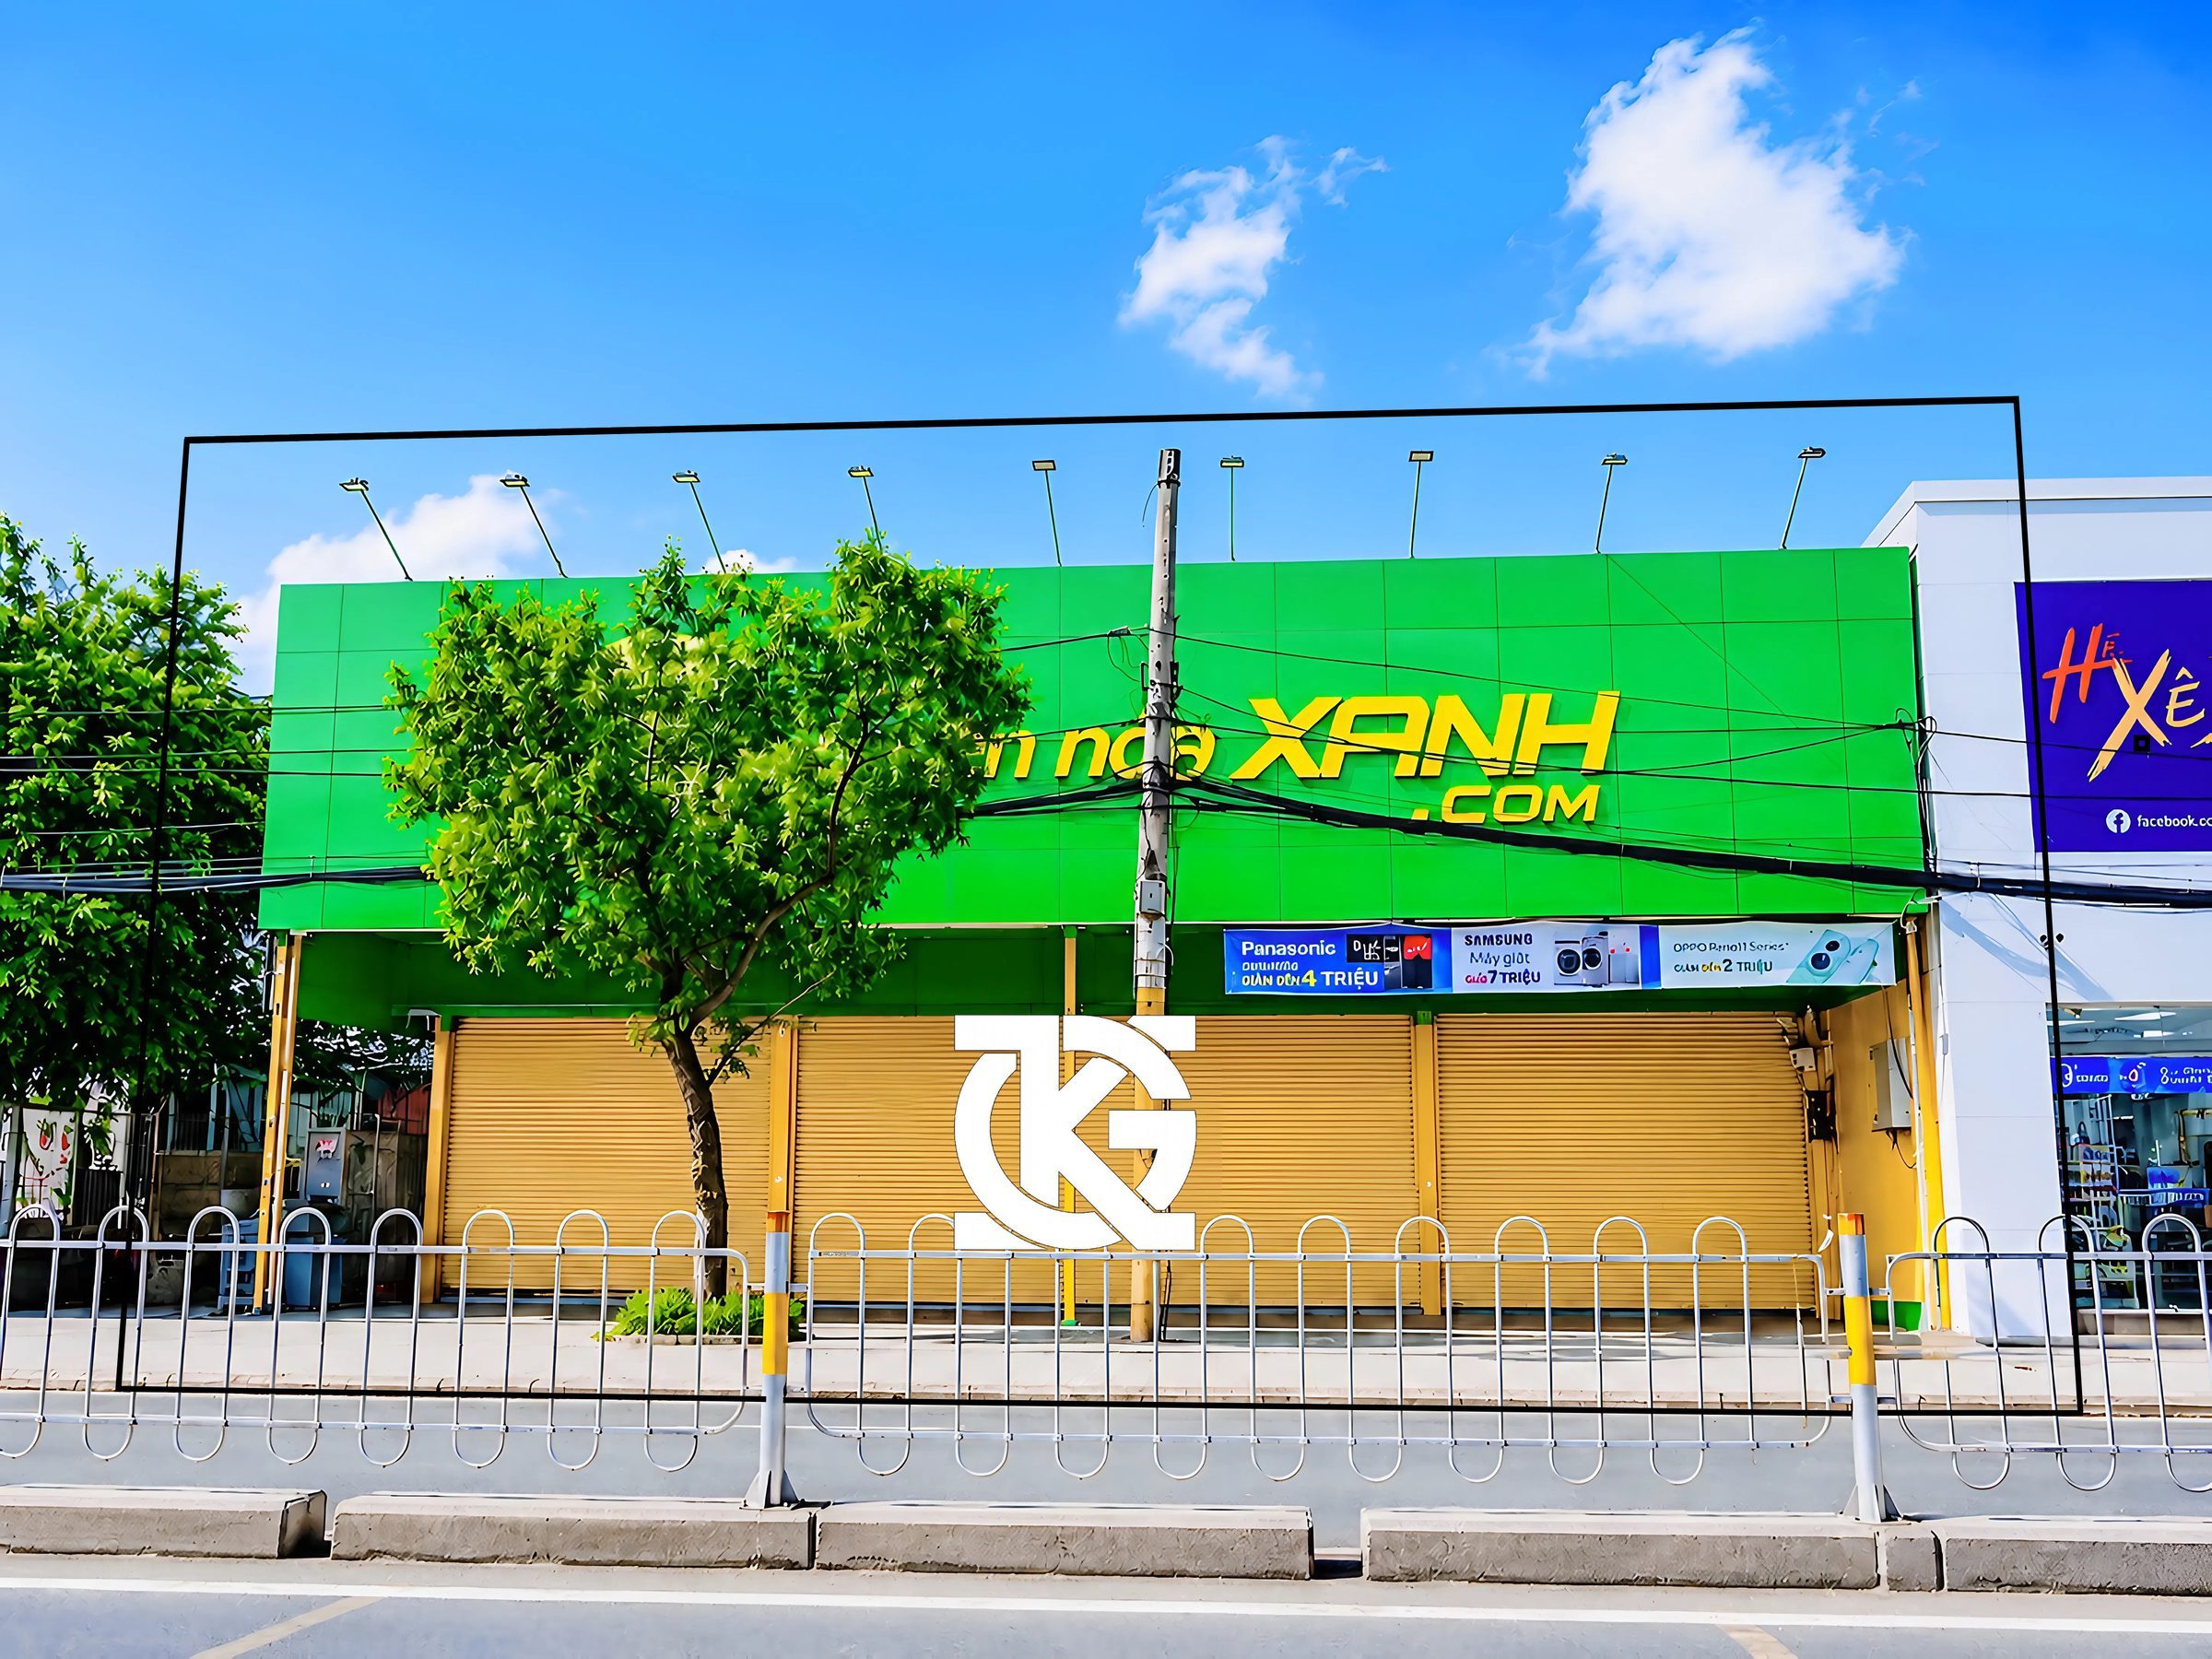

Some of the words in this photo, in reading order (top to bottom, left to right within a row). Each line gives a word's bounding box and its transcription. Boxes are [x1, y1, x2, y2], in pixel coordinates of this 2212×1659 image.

[1230, 690, 1621, 780] XANH
[1412, 784, 1600, 823] .COM
[1241, 940, 1336, 957] Panasonic
[1465, 933, 1533, 947] SAMSUNG
[1722, 959, 1734, 972] 2
[1301, 970, 1317, 987] 4
[1321, 967, 1379, 990] TRIỆU
